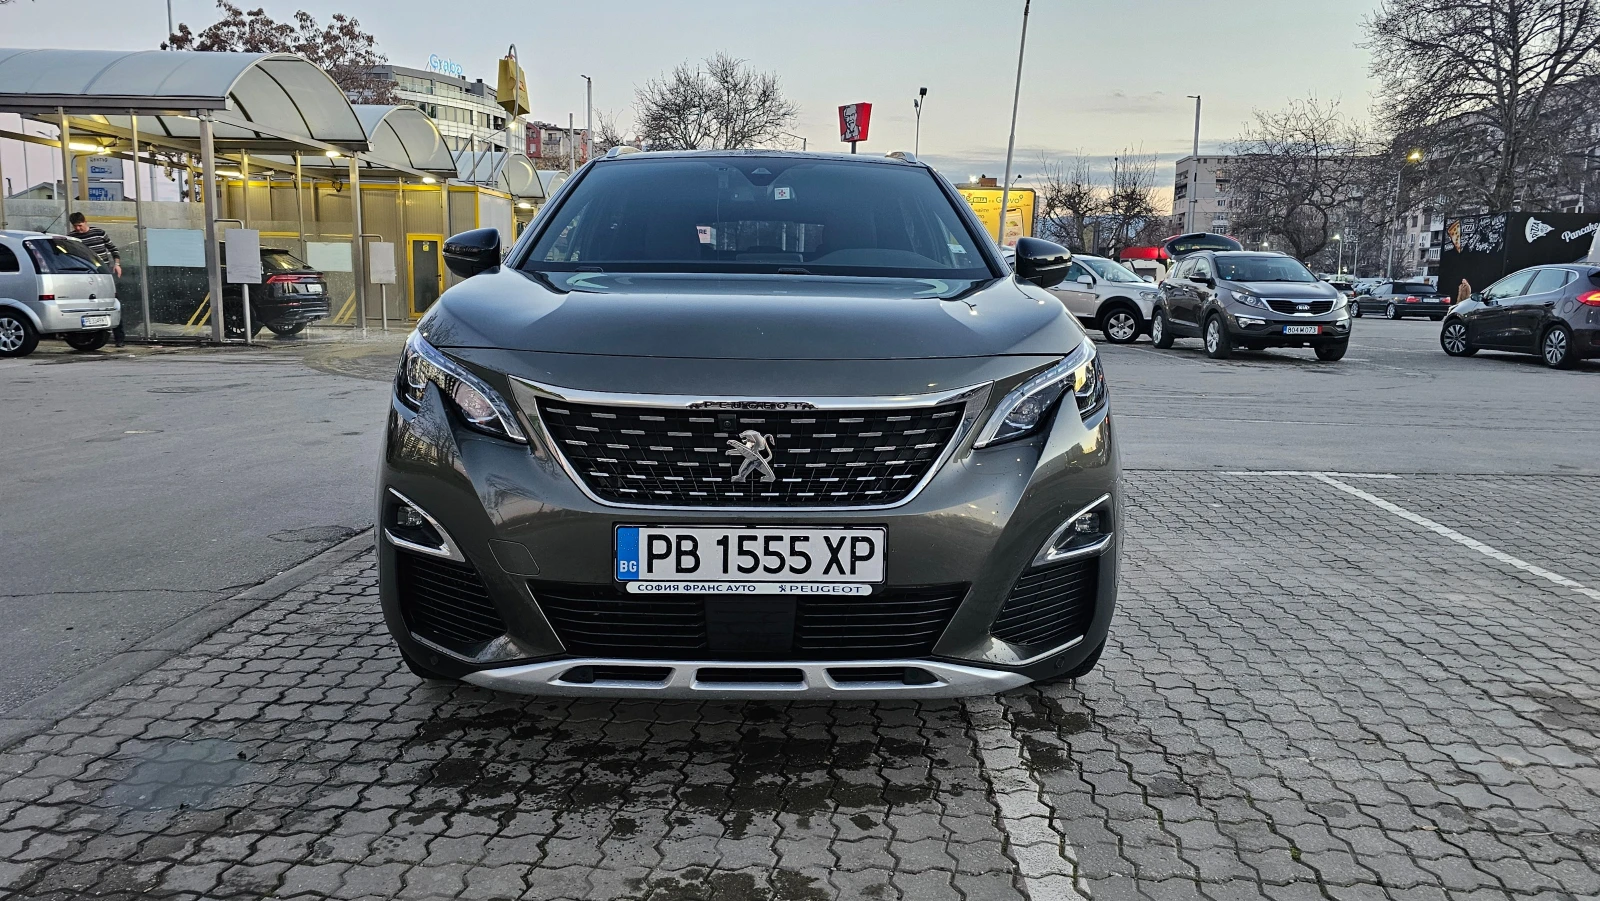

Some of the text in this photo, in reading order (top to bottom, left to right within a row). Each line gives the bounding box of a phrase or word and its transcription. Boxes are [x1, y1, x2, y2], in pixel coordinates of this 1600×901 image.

[429, 53, 463, 75] Grabo
[704, 401, 801, 409] PEUGEOT
[646, 533, 876, 576] PB 1555 XP
[619, 560, 637, 573] BG
[637, 584, 757, 593] СОФИЯ ФРАНС АУТО
[789, 585, 863, 594] PEUGEOT
